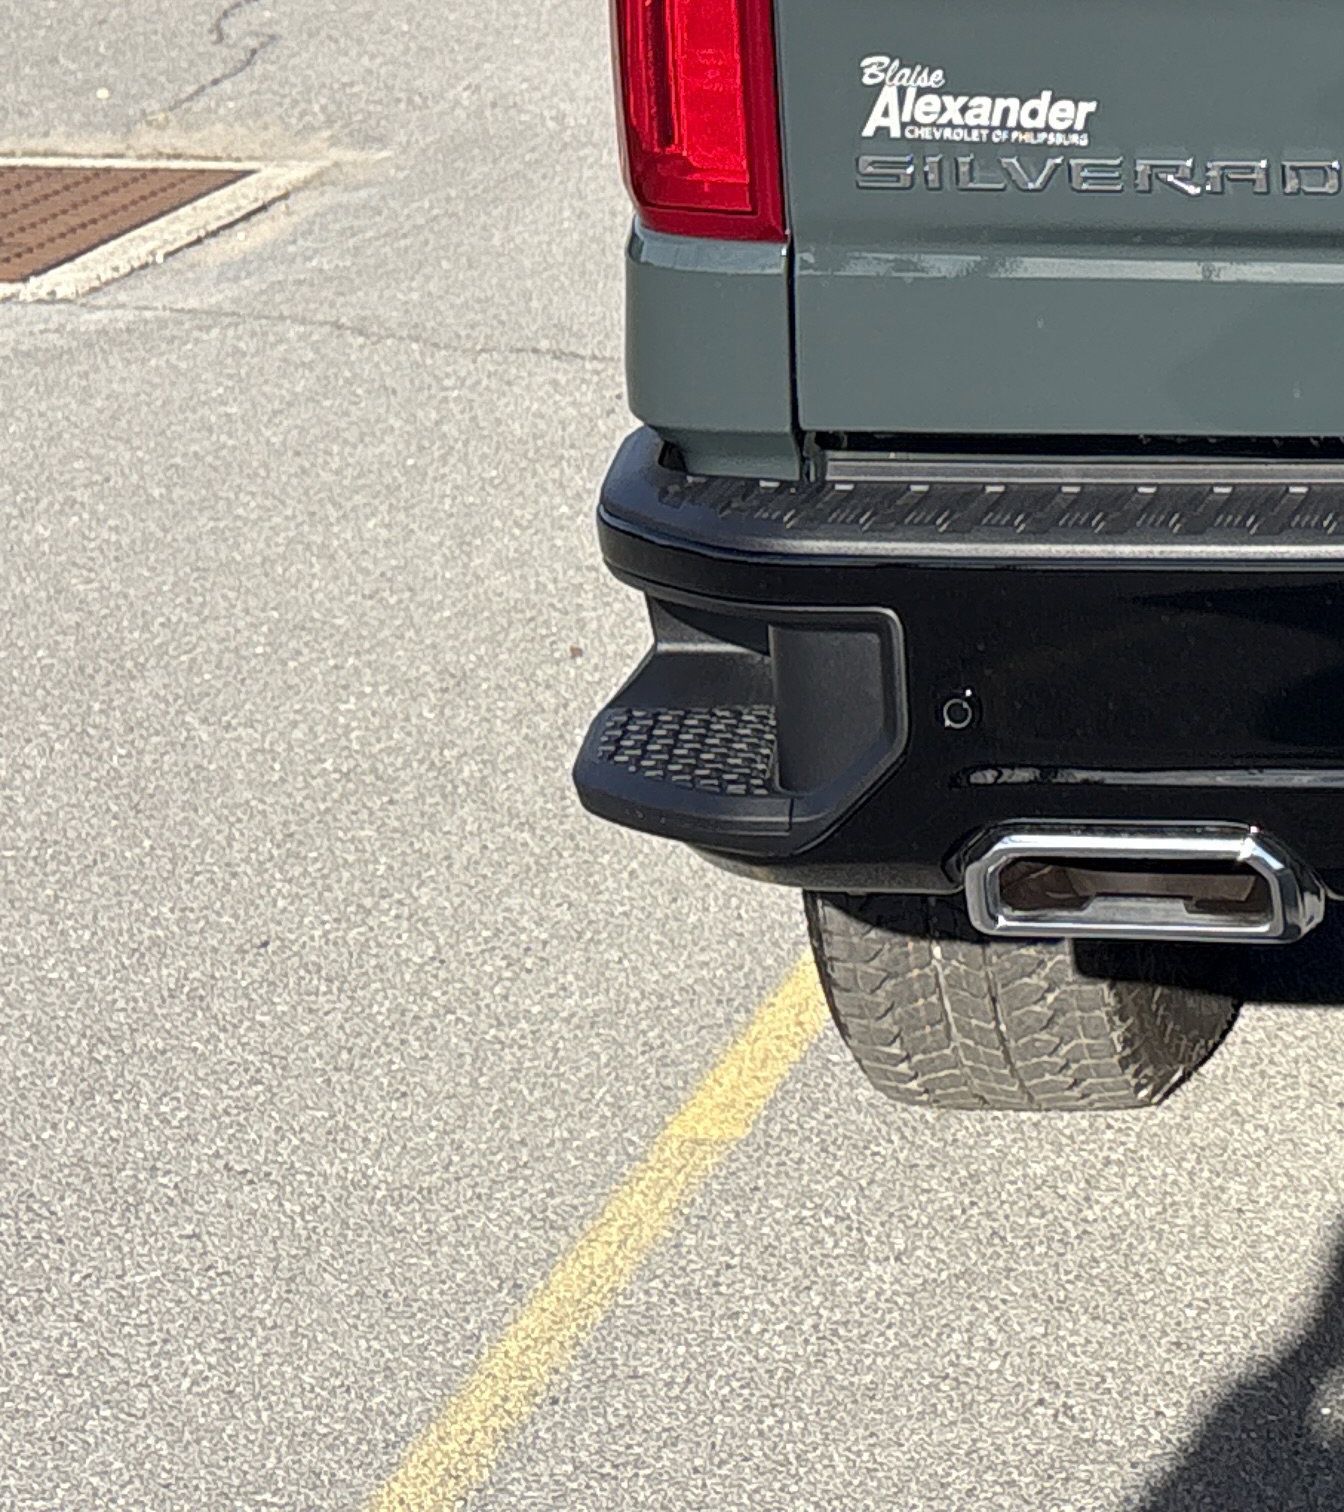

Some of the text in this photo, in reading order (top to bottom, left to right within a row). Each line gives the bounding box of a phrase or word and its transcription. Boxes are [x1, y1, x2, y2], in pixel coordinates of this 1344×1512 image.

[860, 55, 946, 88] Blaise
[861, 85, 1097, 138] Alexander
[904, 125, 989, 143] CHEVROLET
[991, 130, 1009, 144] OF
